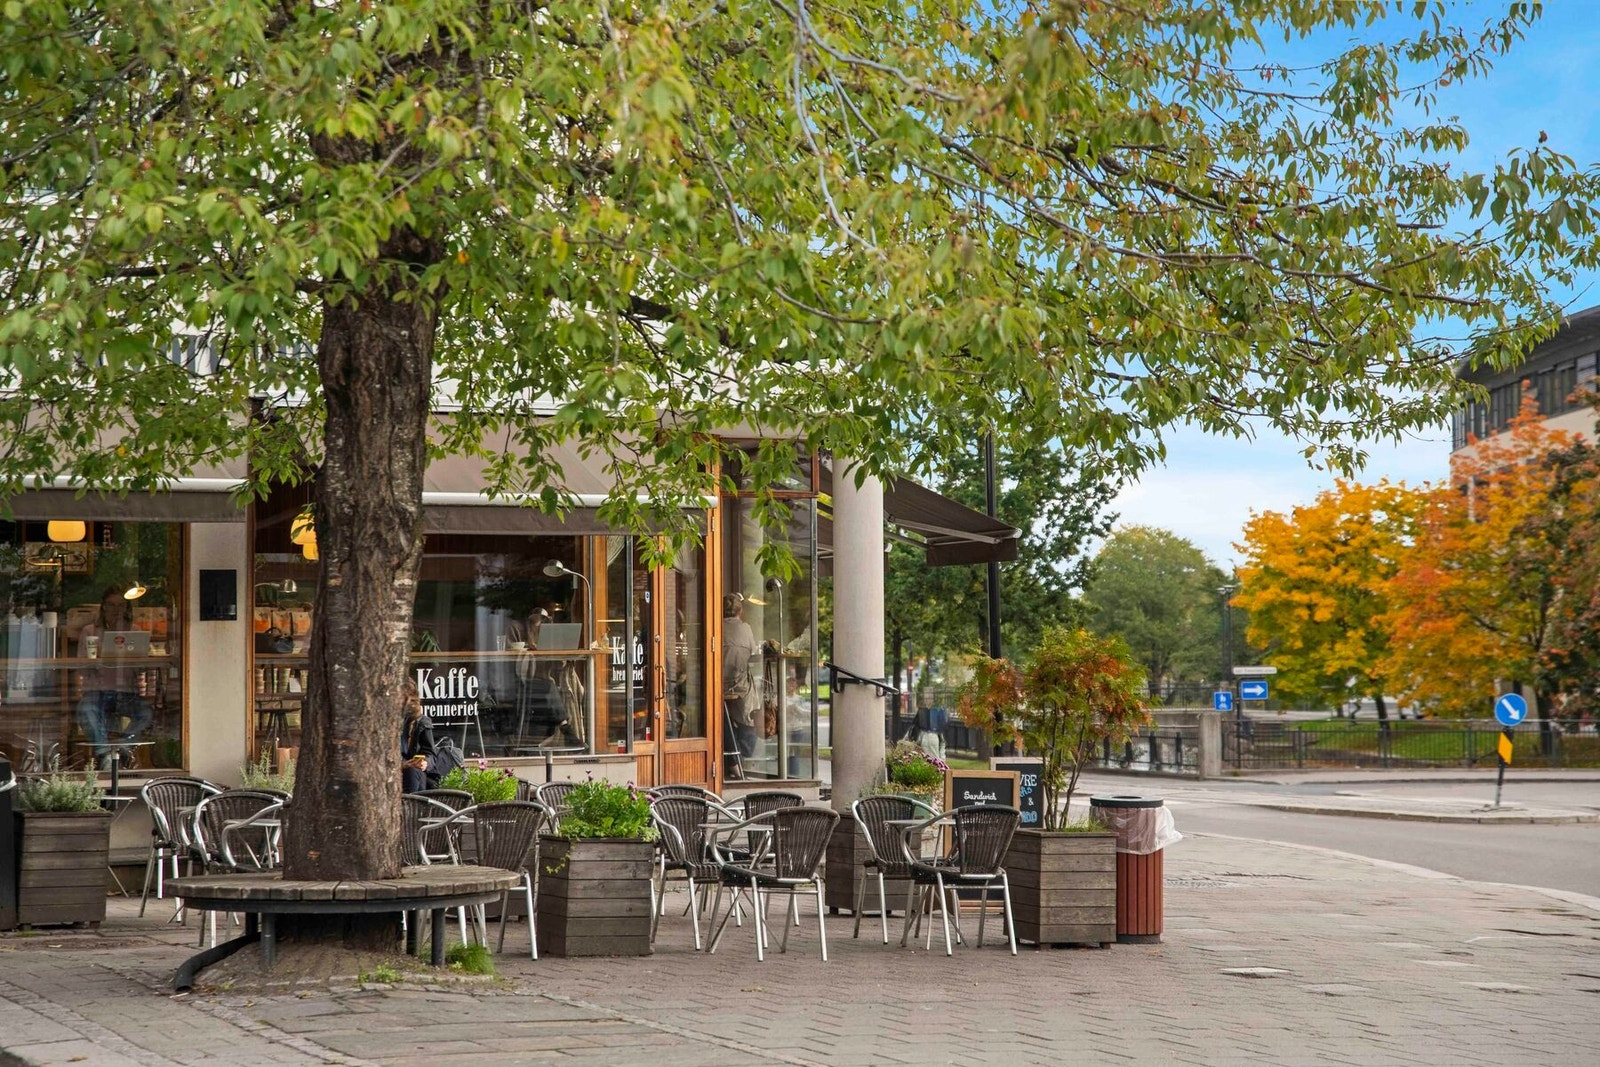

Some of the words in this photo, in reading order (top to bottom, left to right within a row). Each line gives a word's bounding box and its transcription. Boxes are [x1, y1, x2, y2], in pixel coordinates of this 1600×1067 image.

[612, 635, 644, 665] Kafe
[612, 666, 644, 681] brenriet
[416, 667, 479, 699] Kaffe
[963, 790, 997, 801] Sandwich
[1028, 797, 1034, 806] &
